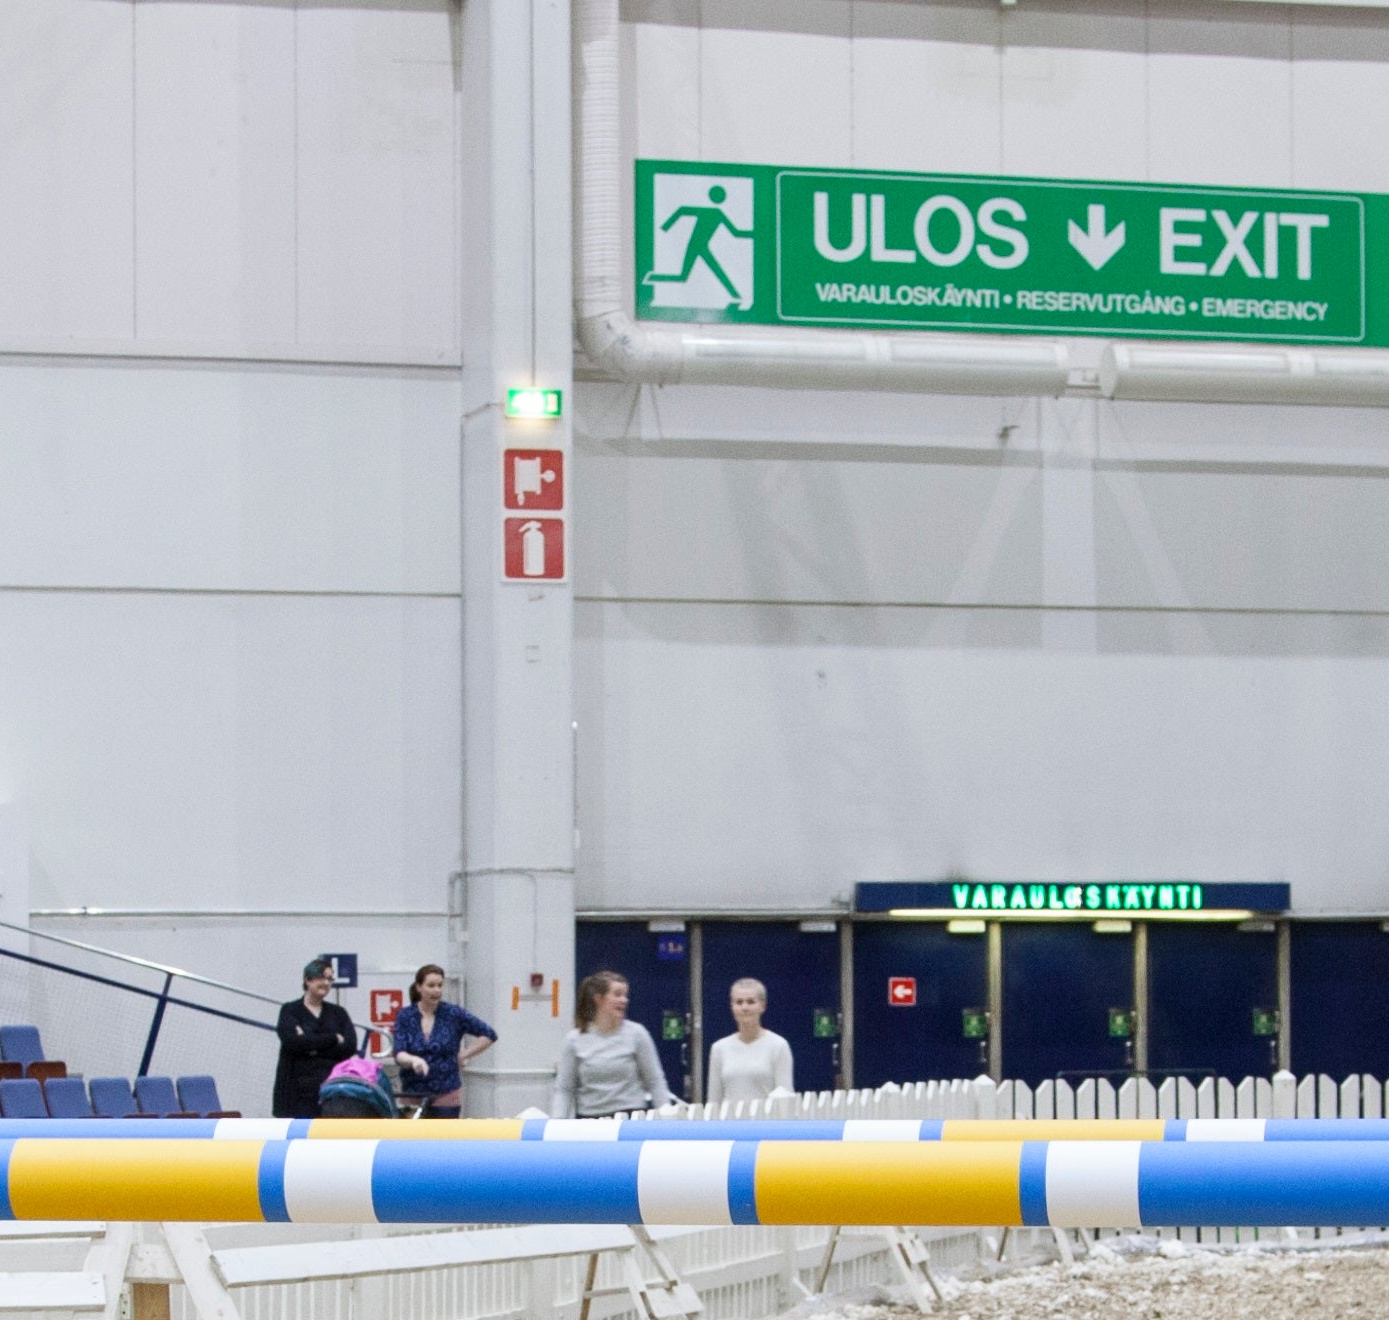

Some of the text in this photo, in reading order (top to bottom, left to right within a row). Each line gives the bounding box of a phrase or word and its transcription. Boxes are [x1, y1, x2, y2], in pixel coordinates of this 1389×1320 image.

[815, 192, 1328, 279] ULOS EXIT
[816, 284, 1327, 320] VARAULOSKÄYNTI RESERVUTGÅNG EMERGENCY
[952, 882, 1202, 909] VARAULOSKÄYNTI
